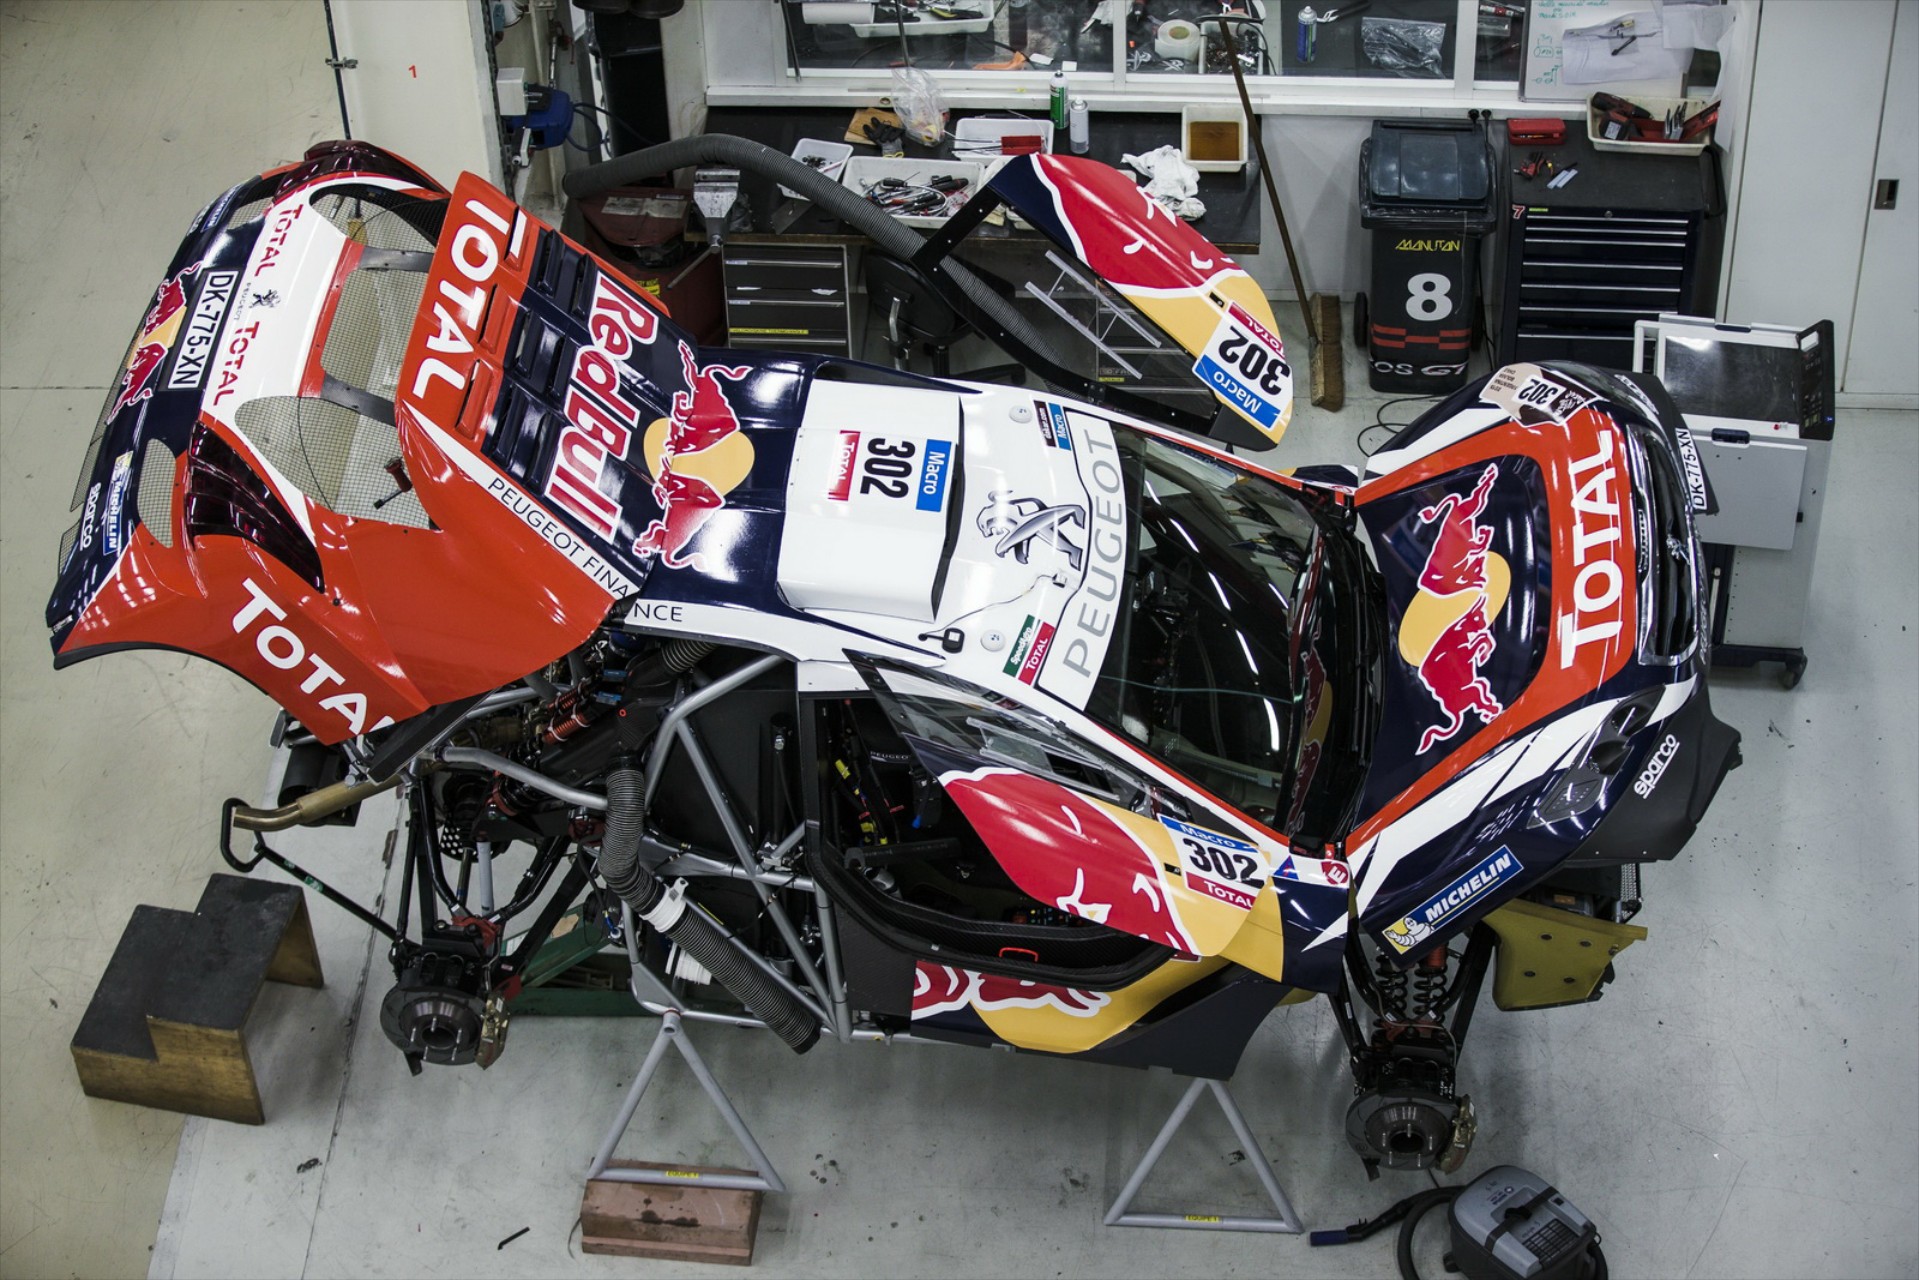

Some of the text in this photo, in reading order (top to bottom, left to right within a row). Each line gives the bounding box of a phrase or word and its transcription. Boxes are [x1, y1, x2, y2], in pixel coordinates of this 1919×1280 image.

[408, 64, 418, 78] 1
[1512, 204, 1526, 219] 7
[253, 203, 304, 278] TOTAL
[1395, 239, 1461, 252] MANUTAN
[412, 200, 527, 399] TOTAL
[1405, 272, 1453, 322] 8
[173, 273, 236, 387] DK-775-XN
[1247, 316, 1285, 358] TOTAL
[213, 321, 260, 406] TOTAL
[1217, 325, 1290, 396] 302
[1212, 370, 1262, 415] Macro
[1517, 378, 1558, 405] 302
[1040, 407, 1053, 440] dakar.com
[1056, 414, 1068, 440] Macro
[833, 442, 856, 482] TOTAL
[860, 437, 916, 499] 302
[923, 451, 946, 495] Macro
[1676, 430, 1706, 508] DK-775-XN
[79, 482, 102, 551] sparco
[487, 476, 584, 560] PEUGEOT
[1062, 428, 1124, 679] PEUGEOT
[1560, 430, 1623, 670] TOTAL
[1025, 637, 1049, 671] TOTAL
[1633, 733, 1680, 797] sparco
[1180, 824, 1237, 848] Macro
[1182, 838, 1265, 889] 302
[1425, 852, 1511, 922] MICHELIN
[1203, 880, 1253, 908] TOTAL
